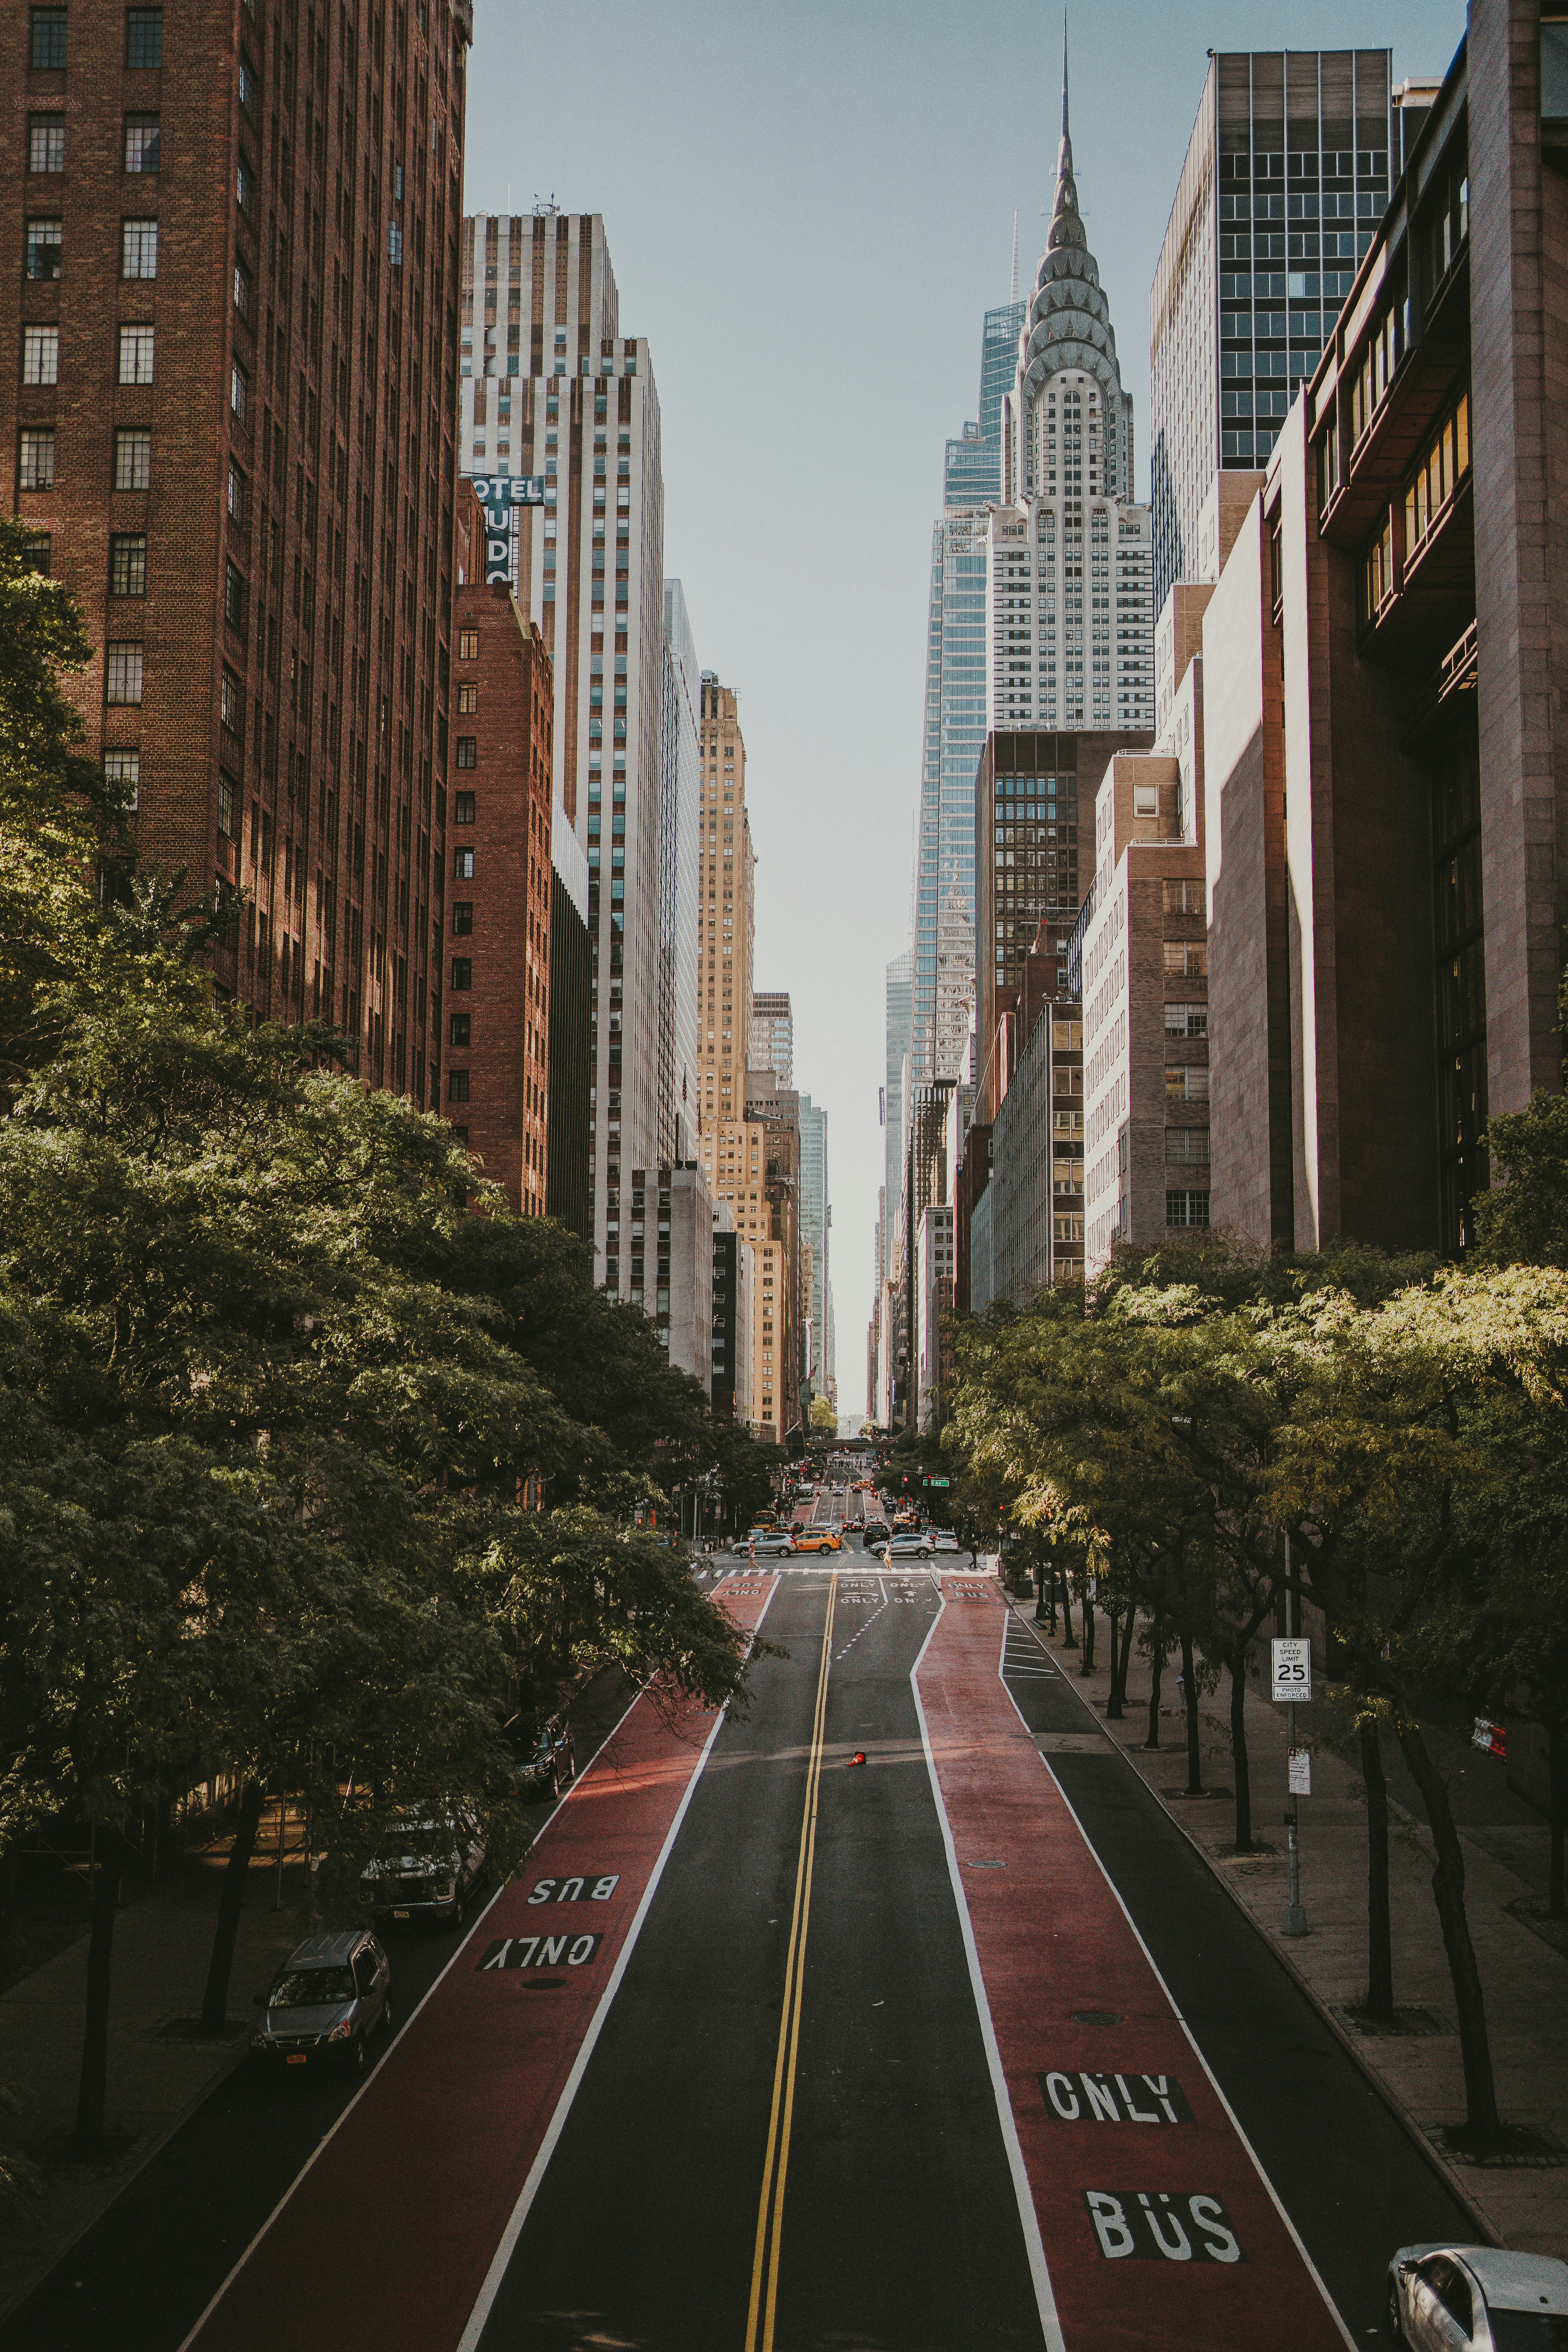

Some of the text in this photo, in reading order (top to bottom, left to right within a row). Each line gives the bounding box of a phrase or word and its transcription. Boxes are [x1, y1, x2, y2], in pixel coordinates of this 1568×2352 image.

[474, 479, 541, 499] OTEL
[1278, 1665, 1305, 1680] 25
[528, 1875, 621, 1904] BUS
[483, 1935, 594, 1969] ONLY
[1046, 2072, 1178, 2123] ONLY
[1086, 2191, 1240, 2262] BUS
